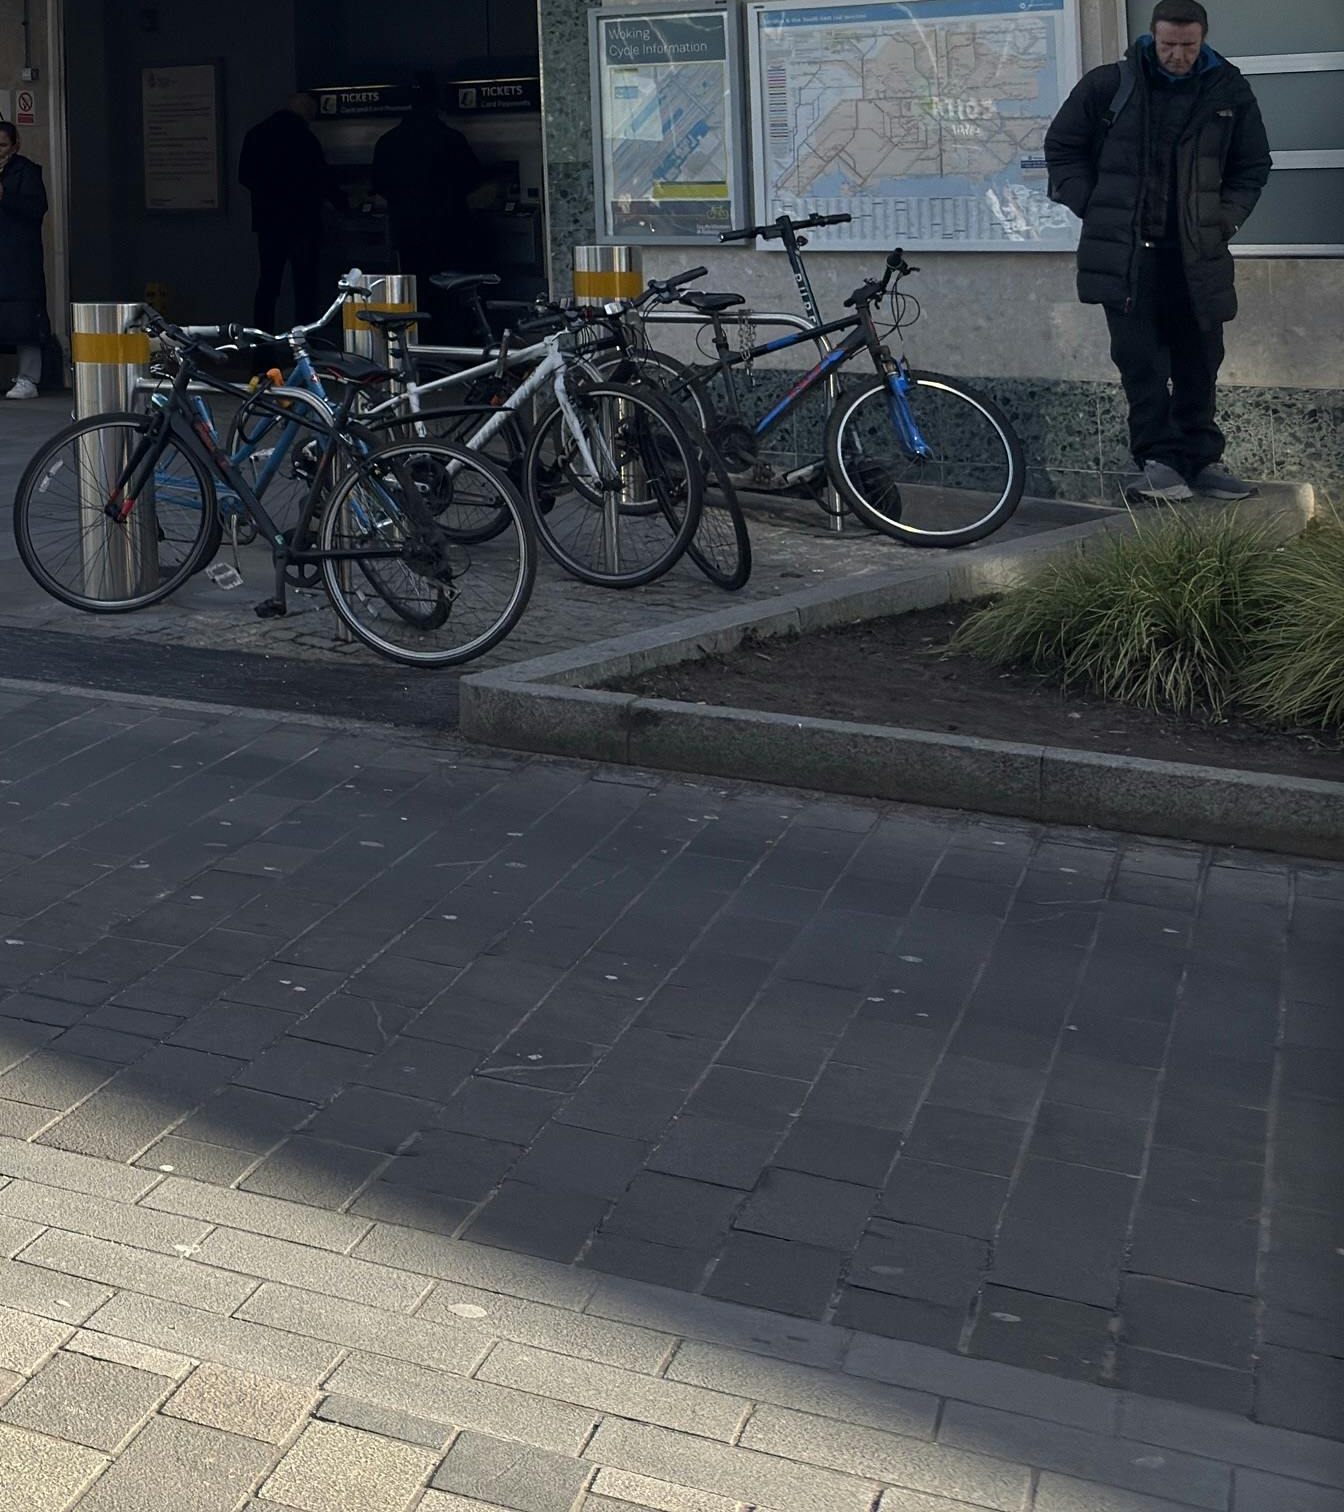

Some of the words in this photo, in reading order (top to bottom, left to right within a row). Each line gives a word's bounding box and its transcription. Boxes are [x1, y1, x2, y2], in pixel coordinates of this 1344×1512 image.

[609, 27, 650, 41] Woking
[609, 44, 640, 59] Cycle
[643, 42, 709, 55] Information
[340, 91, 380, 103] TICKETS
[481, 85, 523, 97] TICKETS
